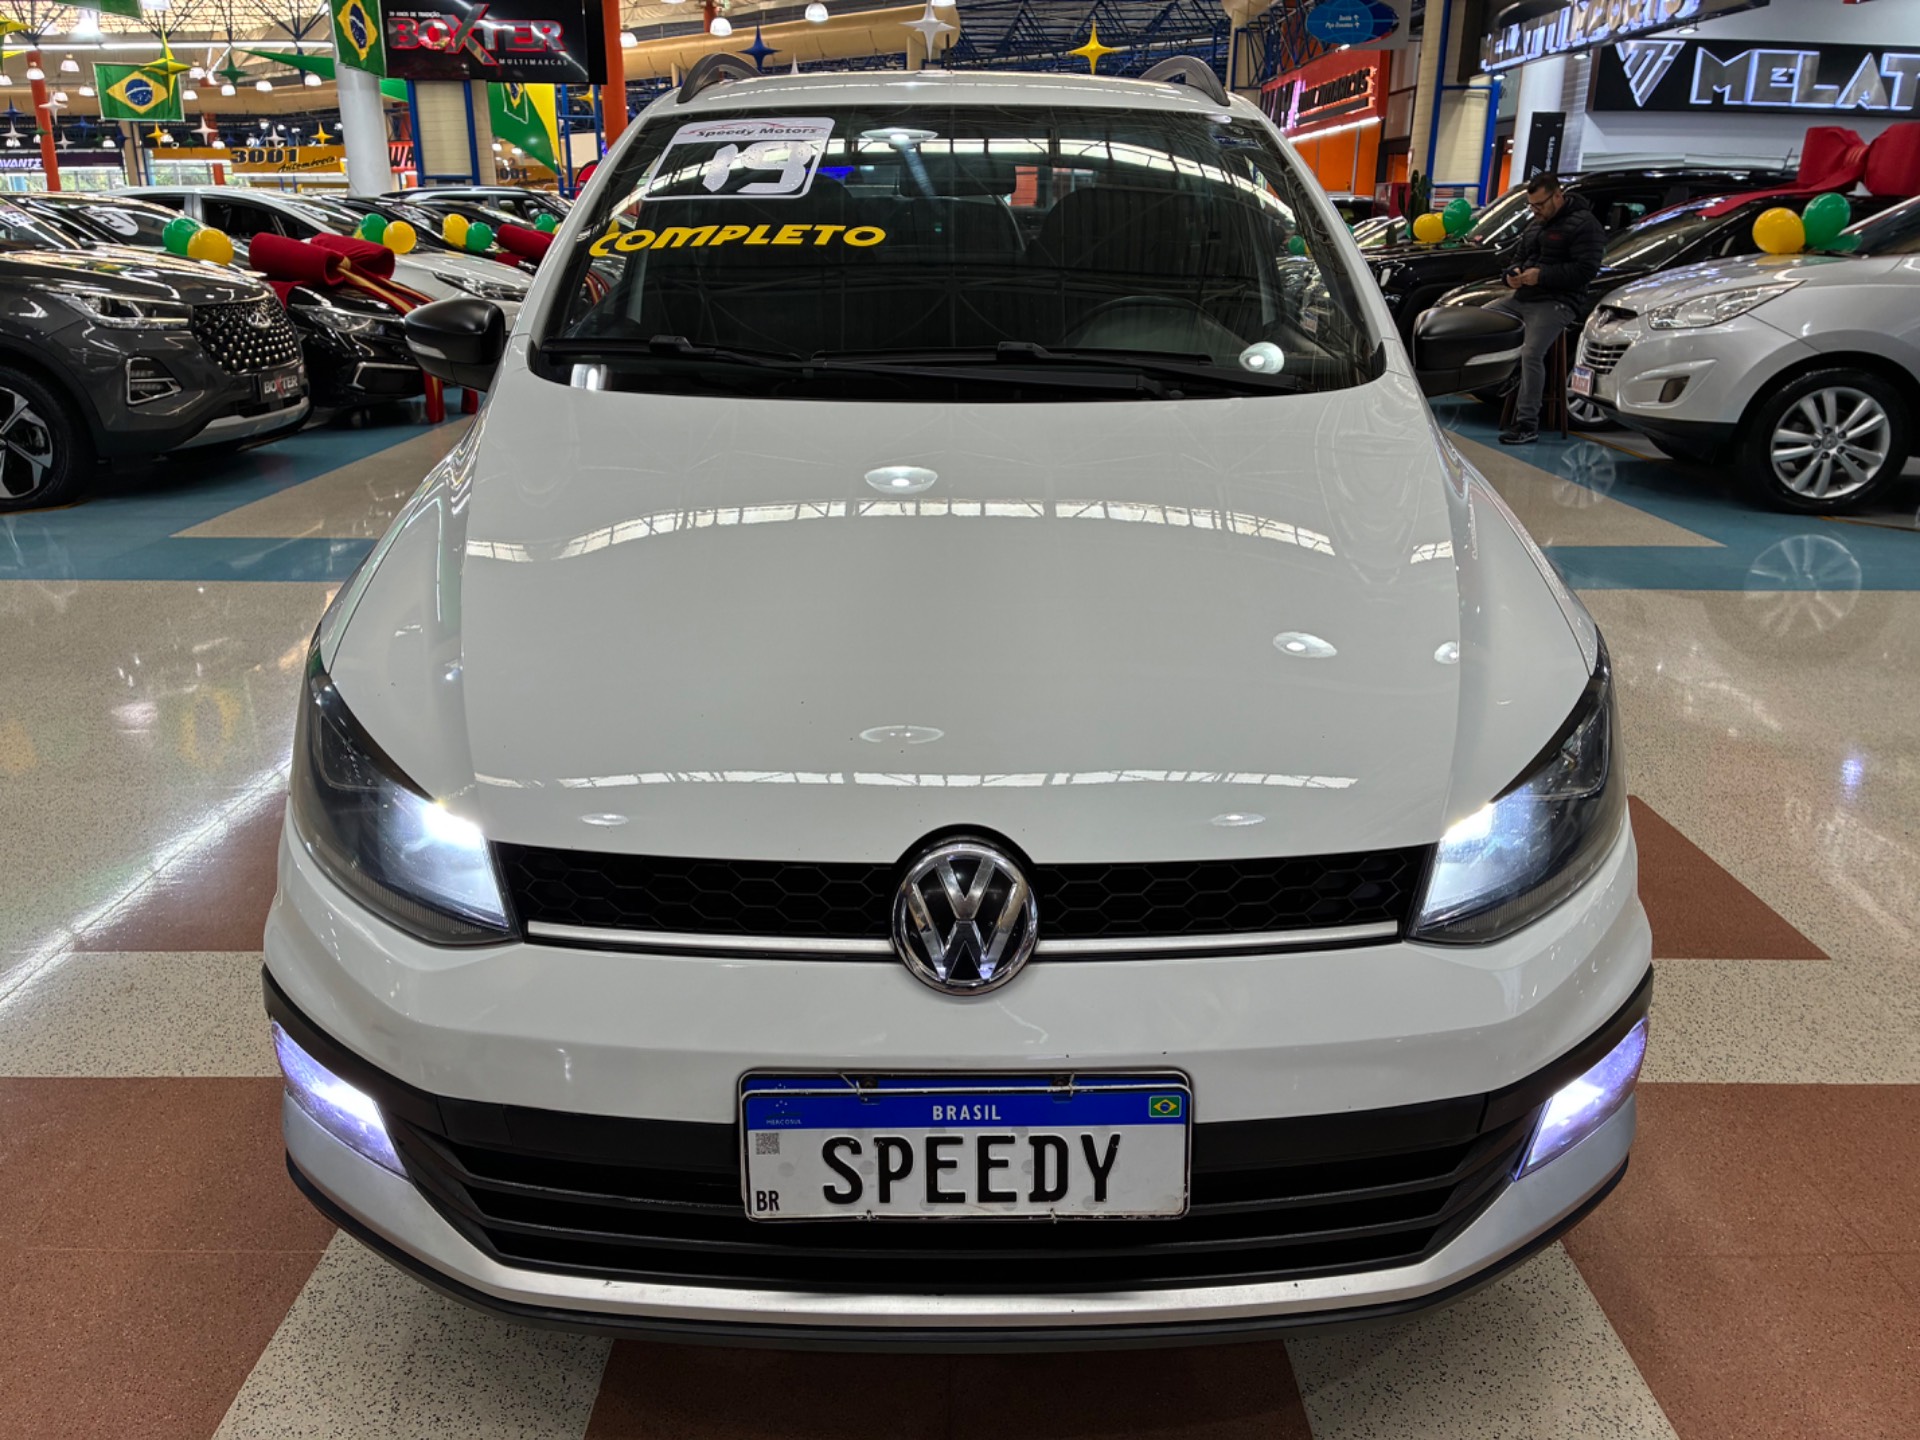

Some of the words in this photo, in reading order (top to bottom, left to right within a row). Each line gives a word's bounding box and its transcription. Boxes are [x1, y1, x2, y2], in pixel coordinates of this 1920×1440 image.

[387, 3, 568, 66] BOXTER
[497, 58, 568, 66] MULTIMARCAS
[697, 127, 755, 138] Speedy
[759, 126, 818, 136] Motors
[230, 148, 299, 164] 3001
[702, 141, 813, 193] 19
[589, 225, 887, 257] COMPLETO
[264, 374, 298, 397] BOXTER
[932, 1104, 1002, 1121] BRASIL
[821, 1133, 1122, 1206] SPEEDY
[756, 1190, 780, 1212] BR
